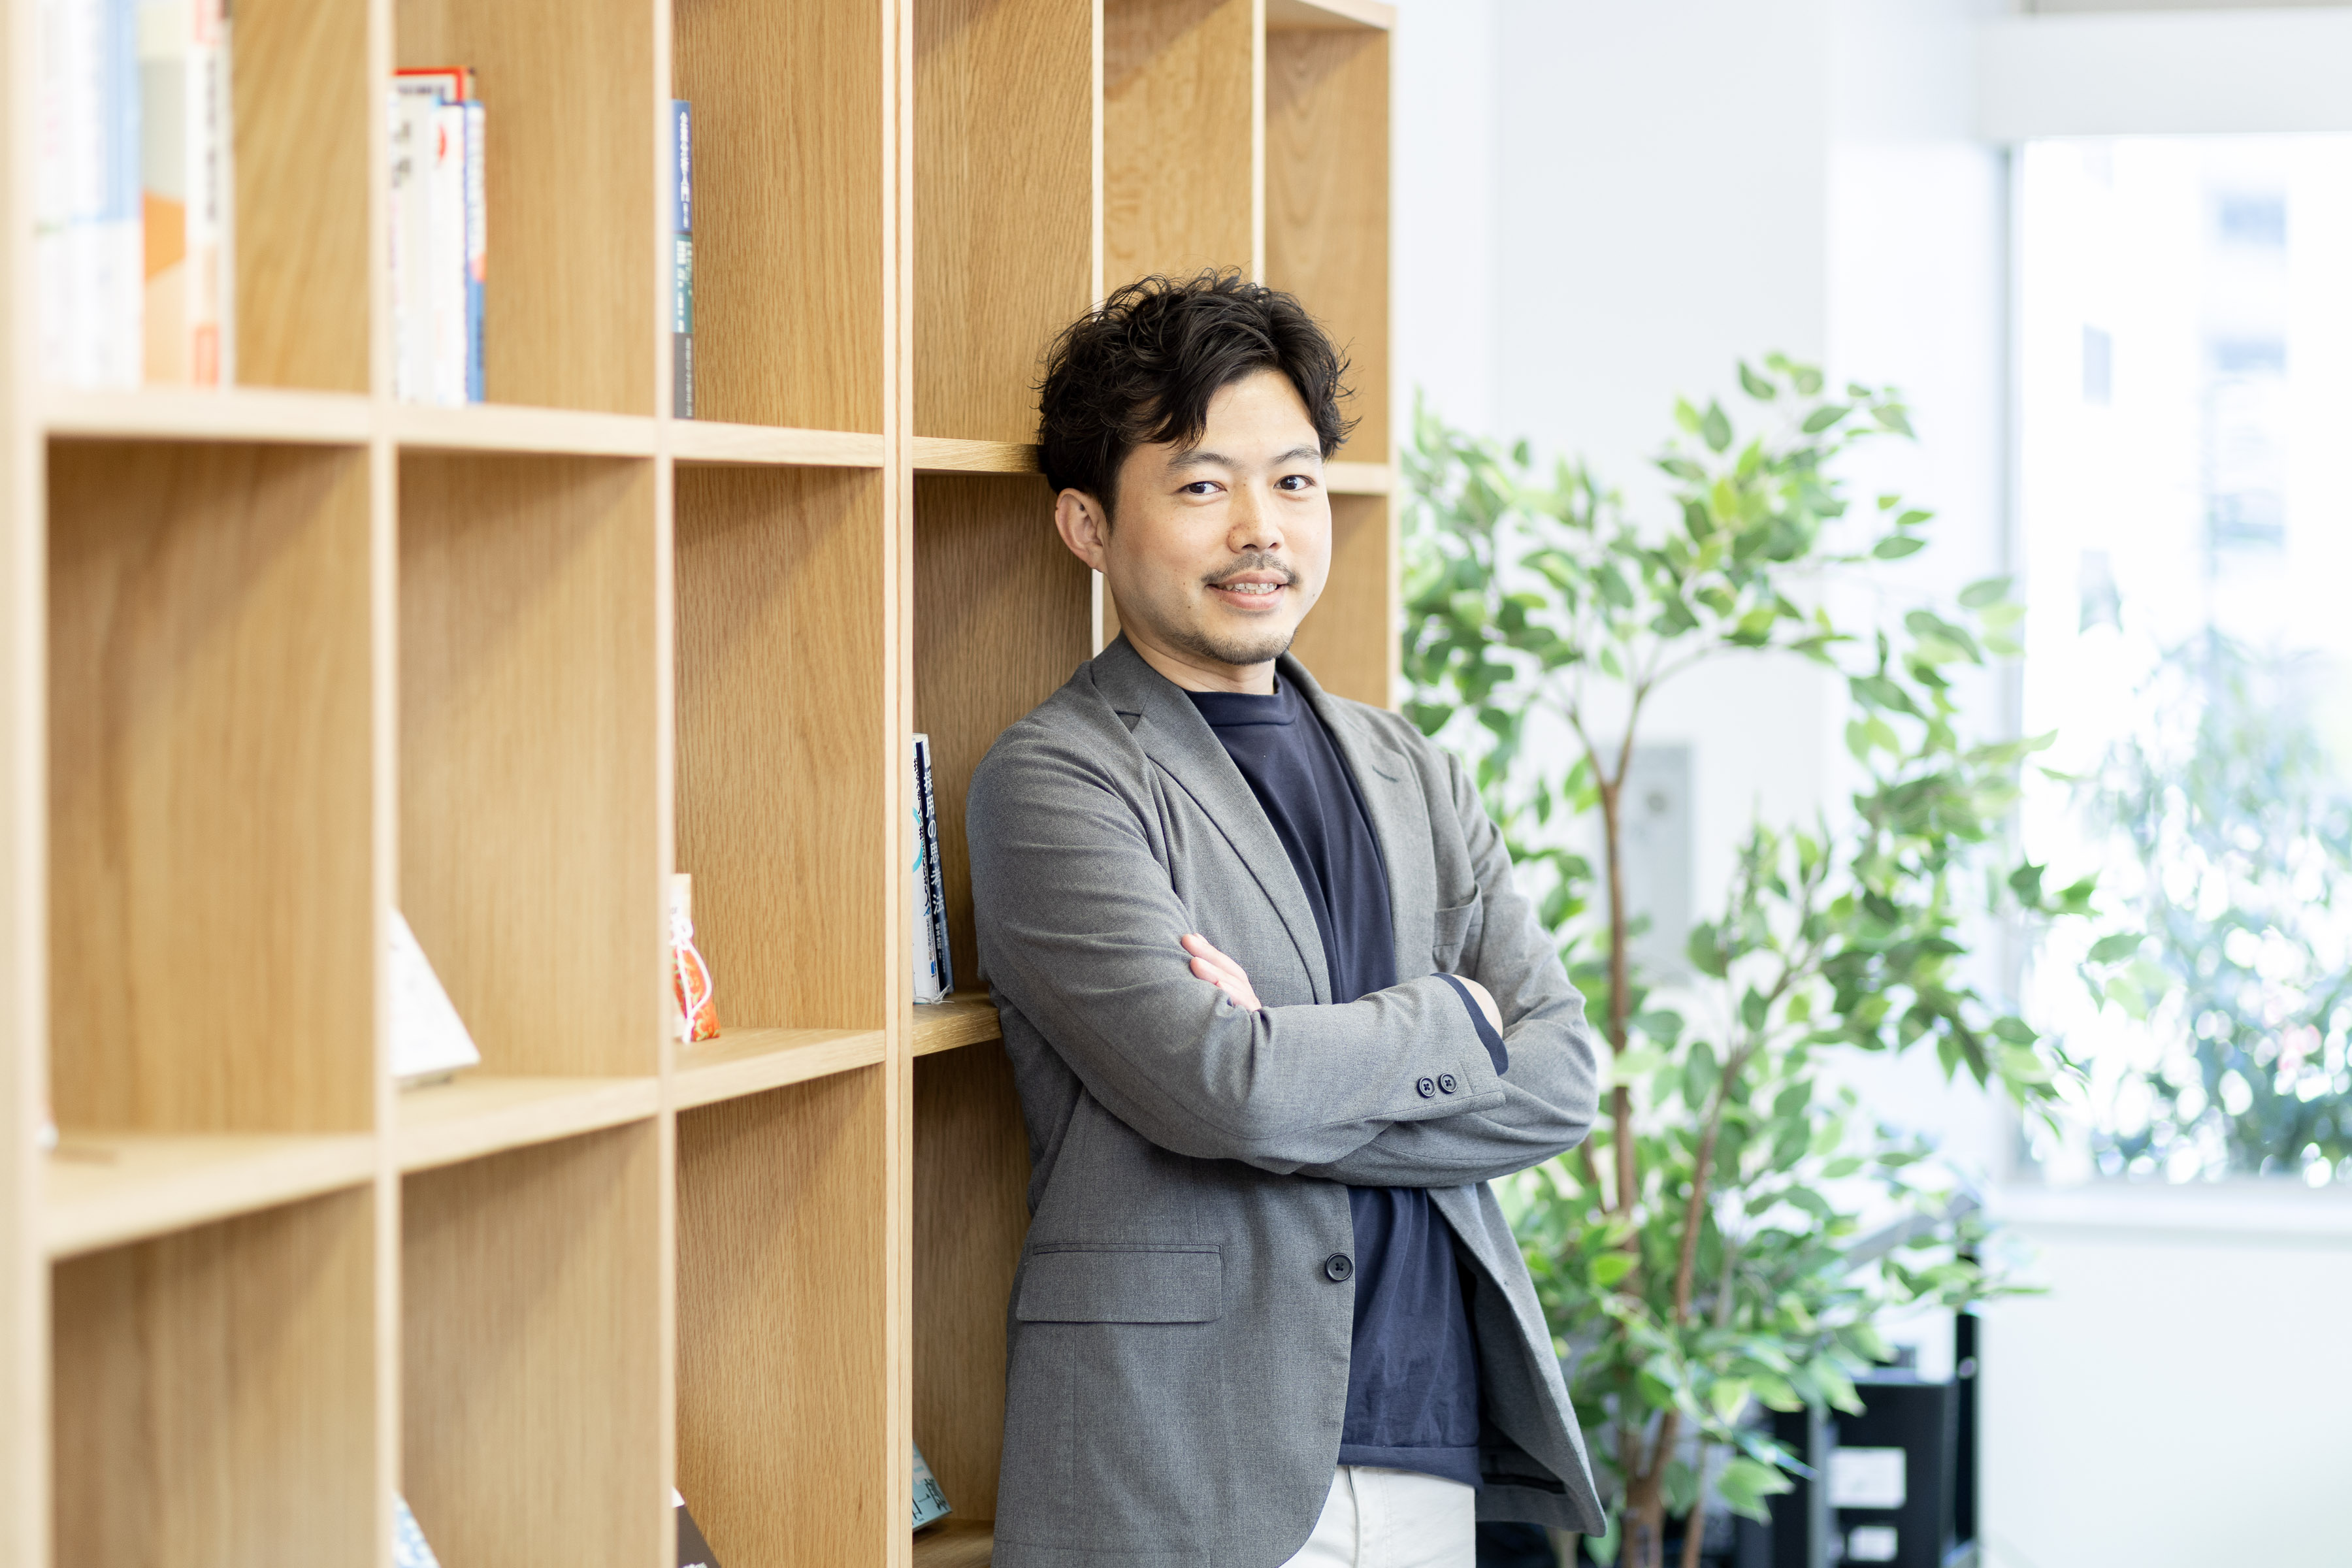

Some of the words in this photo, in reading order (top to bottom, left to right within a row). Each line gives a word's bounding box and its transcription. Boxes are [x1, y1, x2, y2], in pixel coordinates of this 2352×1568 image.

[924, 769, 945, 915] 採用の思考法
